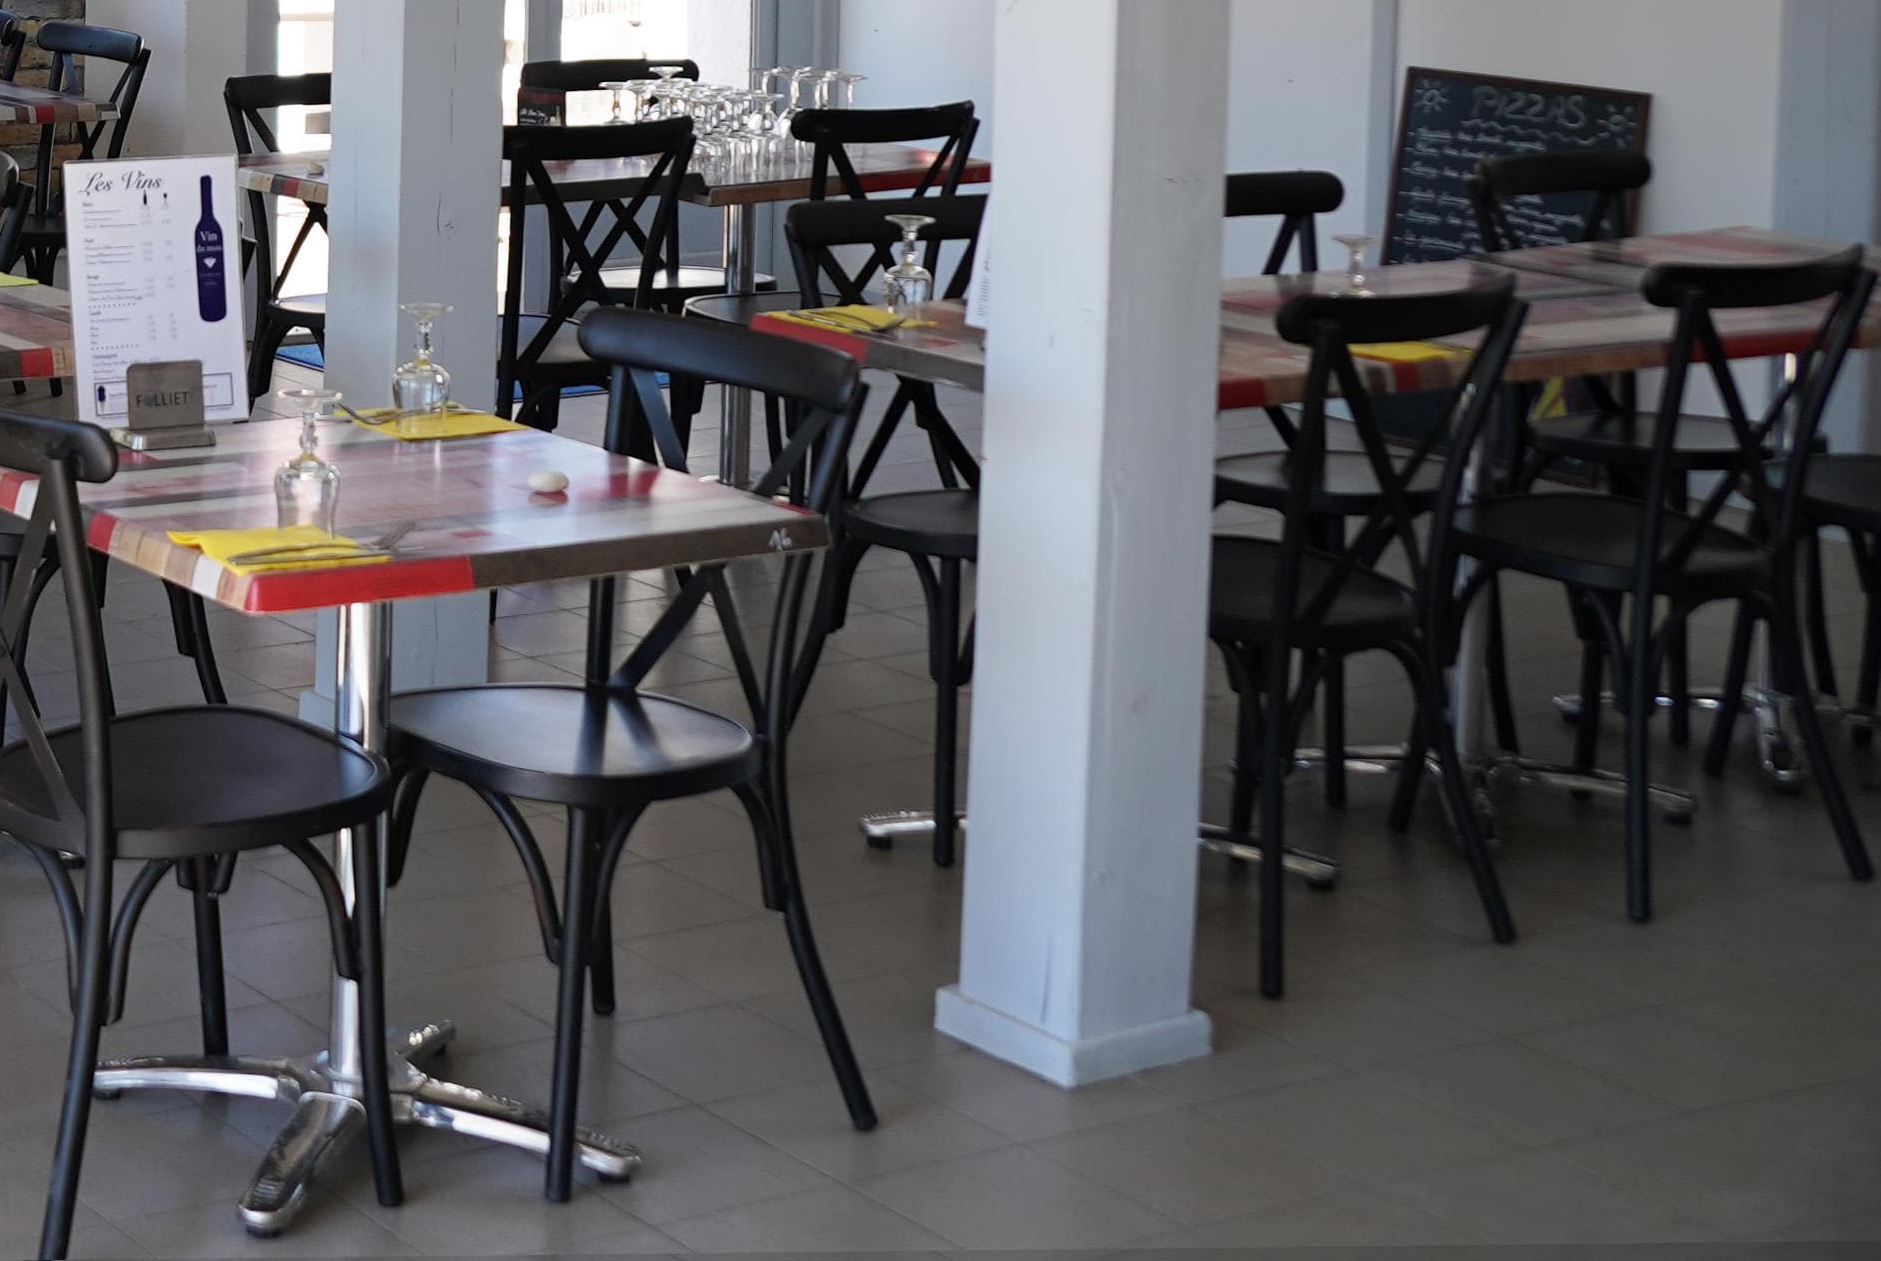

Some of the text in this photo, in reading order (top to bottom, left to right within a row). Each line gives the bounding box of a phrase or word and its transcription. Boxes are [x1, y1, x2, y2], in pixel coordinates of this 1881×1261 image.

[1472, 85, 1587, 130] PIZZAS
[78, 170, 162, 196] Les Vins
[199, 230, 218, 242] Vin
